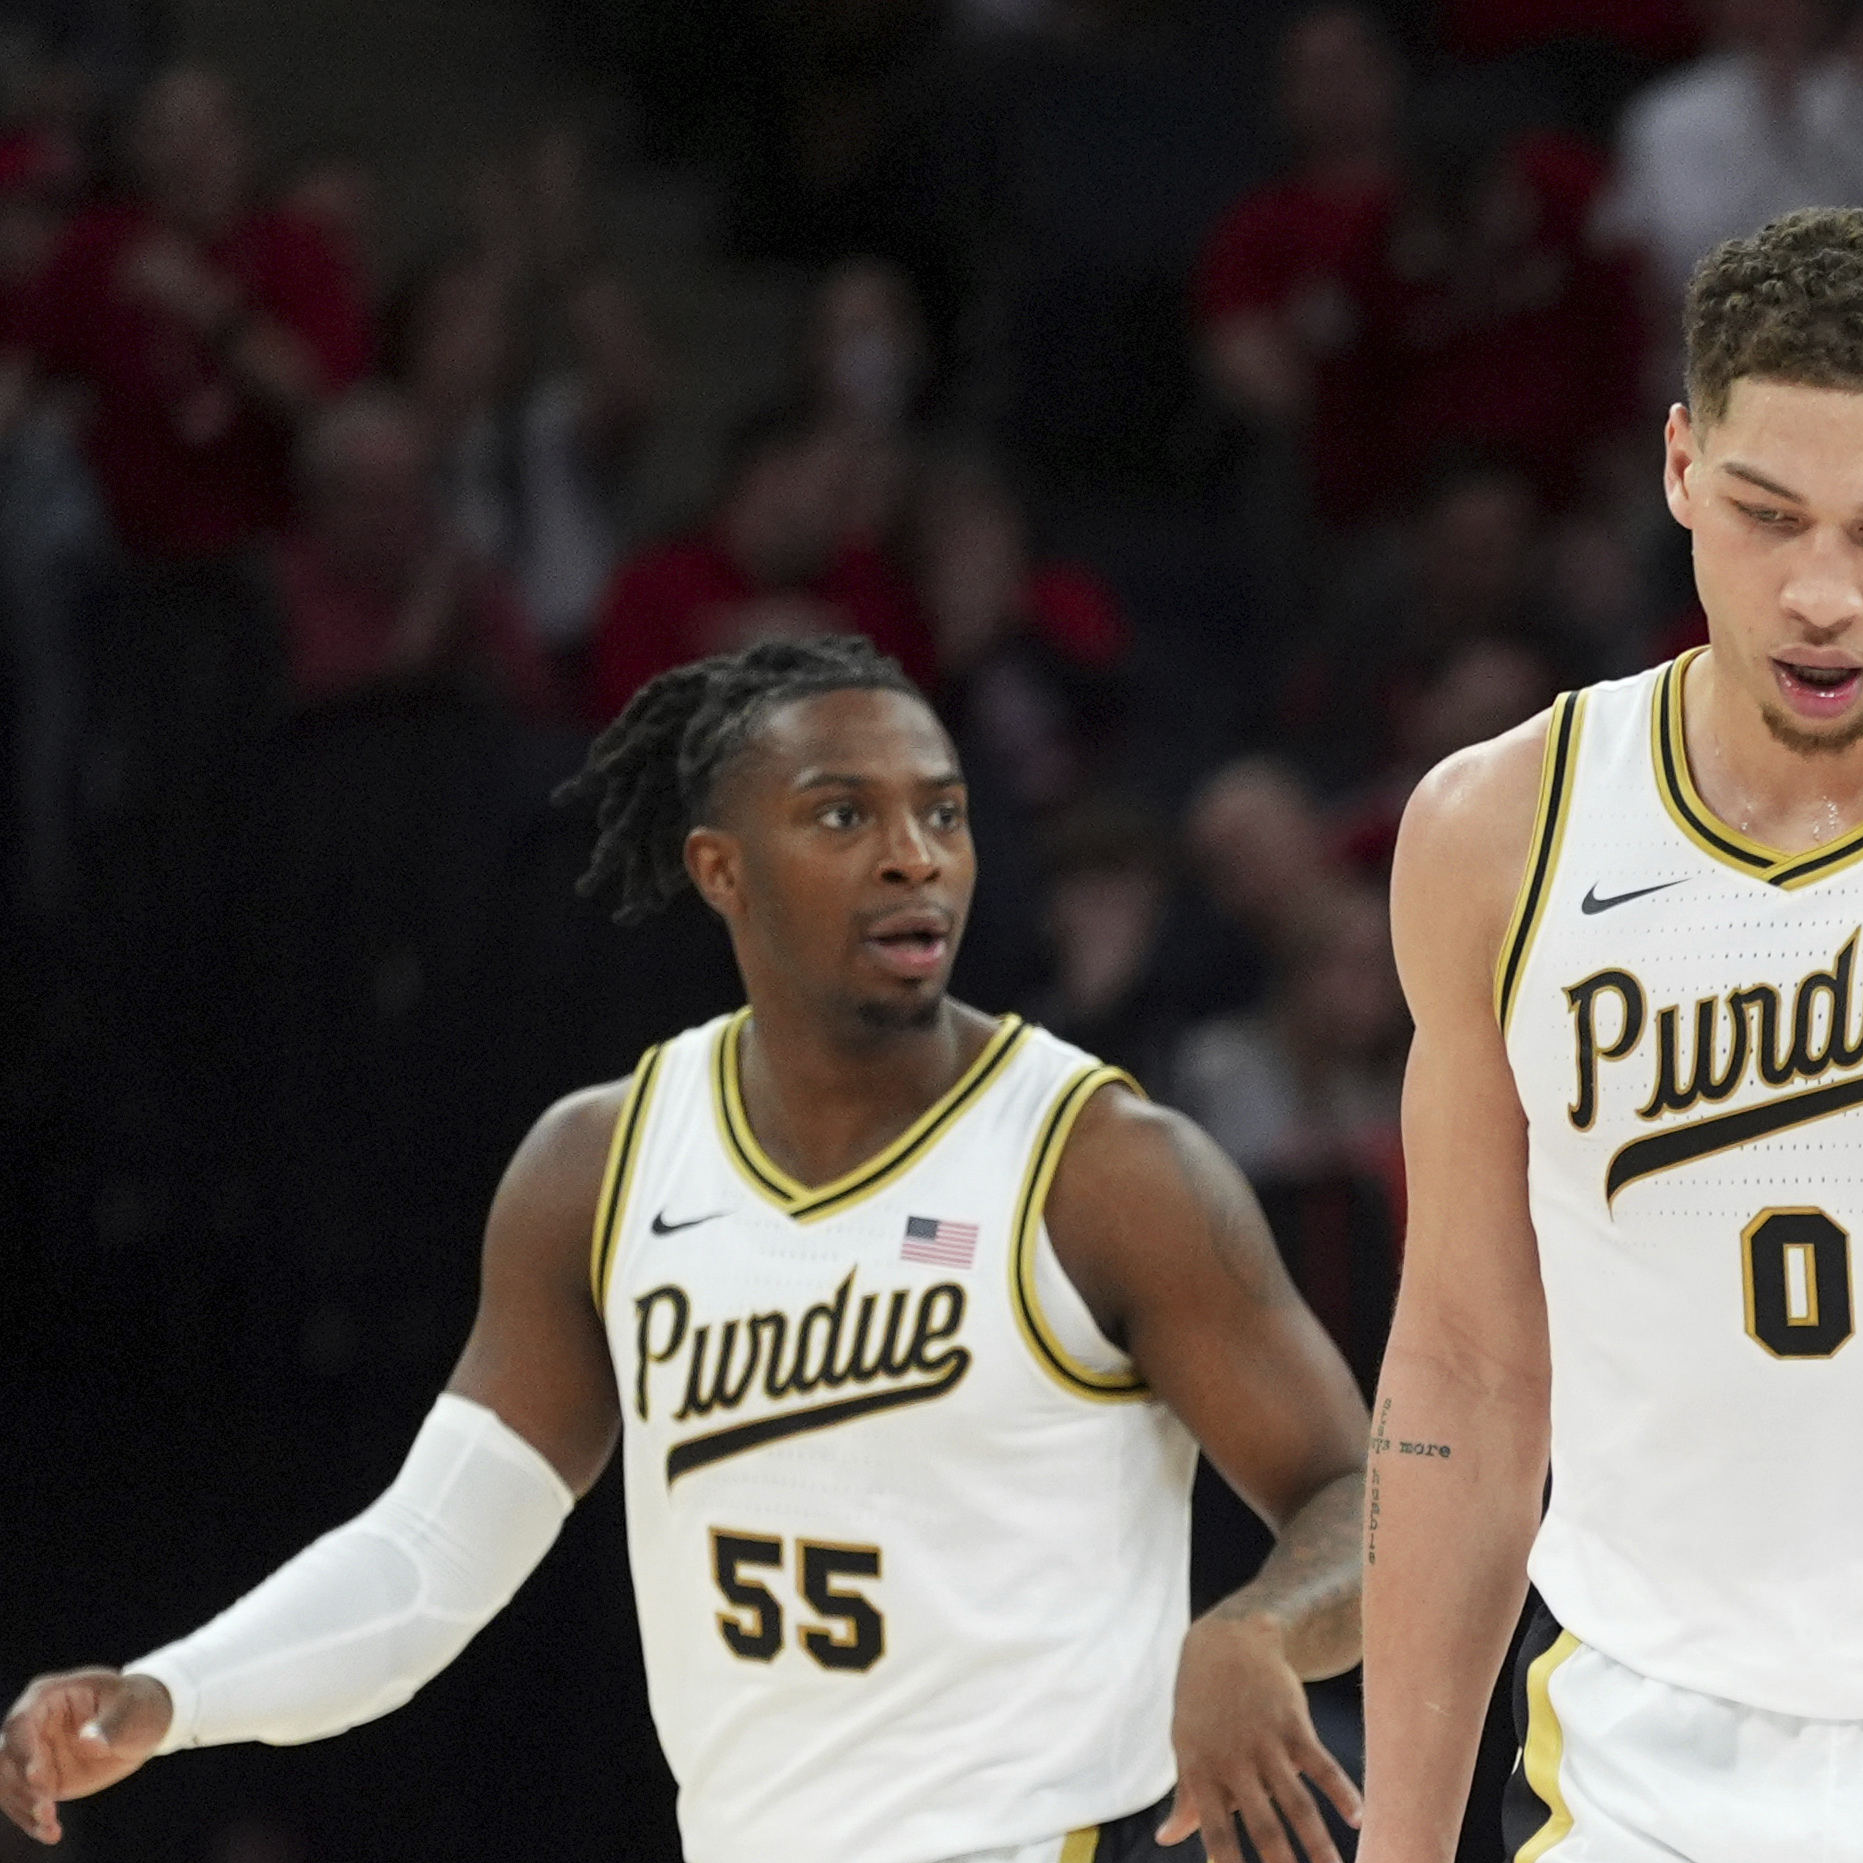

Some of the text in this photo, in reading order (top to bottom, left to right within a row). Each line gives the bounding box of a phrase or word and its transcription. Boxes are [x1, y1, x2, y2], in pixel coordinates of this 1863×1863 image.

[634, 1262, 973, 1423] Purdue
[1740, 1205, 1856, 1361] 0
[1399, 1440, 1451, 1458] more
[708, 1526, 886, 1677] 55
